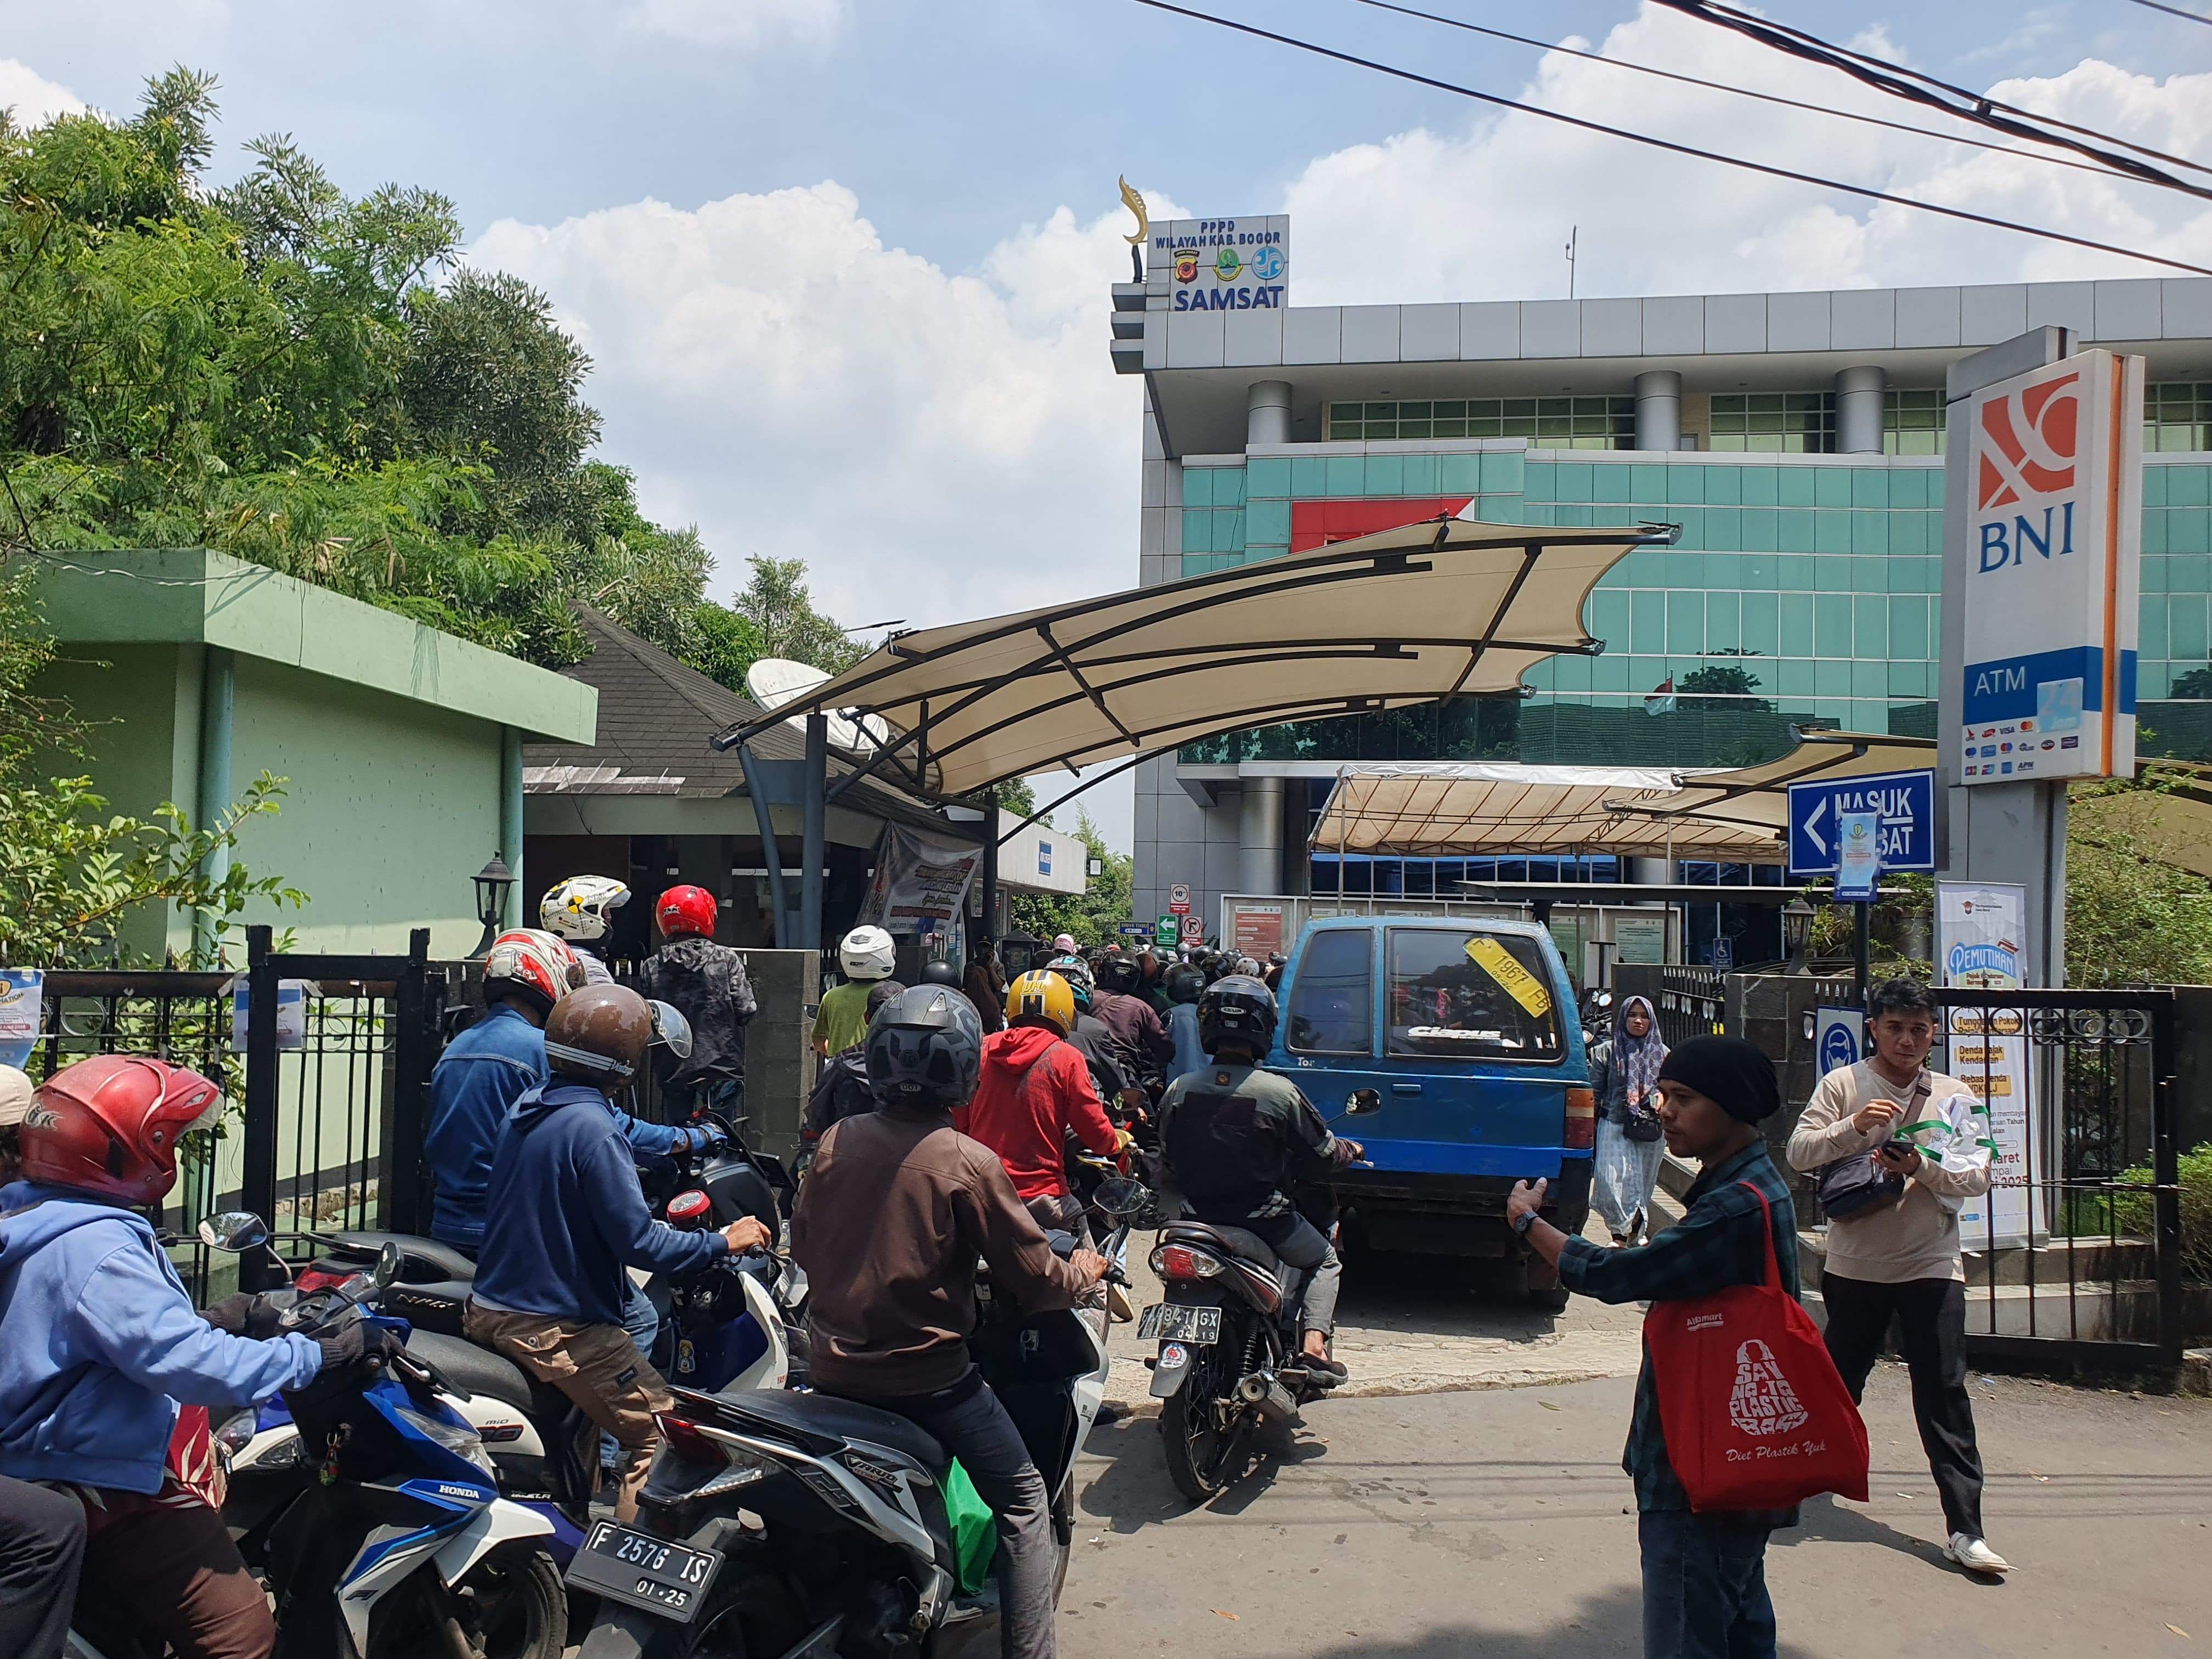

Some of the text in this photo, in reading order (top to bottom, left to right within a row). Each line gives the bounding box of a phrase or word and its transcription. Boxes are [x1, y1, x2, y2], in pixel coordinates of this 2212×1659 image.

[1200, 220, 1235, 234] PPPD
[1155, 232, 1280, 249] WILAYAH KAB. BOGOR
[1174, 285, 1285, 312] SAMSAT
[1977, 500, 2076, 574] BNI
[1973, 665, 2025, 697] ATM
[2039, 680, 2080, 716] 24
[1999, 726, 2015, 735] VISA
[1950, 945, 2015, 981] PEMUTIHAN
[1494, 953, 1529, 985] 1967
[1527, 988, 1548, 1008] FB
[1959, 1045, 2004, 1056] Denda ajak
[1960, 1074, 2007, 1083] Bebas enda
[1200, 1312, 1217, 1327] GX
[1735, 1361, 1785, 1385] SAY
[1730, 1382, 1758, 1401] NO
[1729, 1395, 1804, 1418] PLASTIC
[1726, 1439, 1826, 1462] Diet Plastik Yuk
[844, 1453, 899, 1485] VARIO
[438, 1485, 480, 1499] HONDA
[592, 1527, 708, 1584] F 2576 IS
